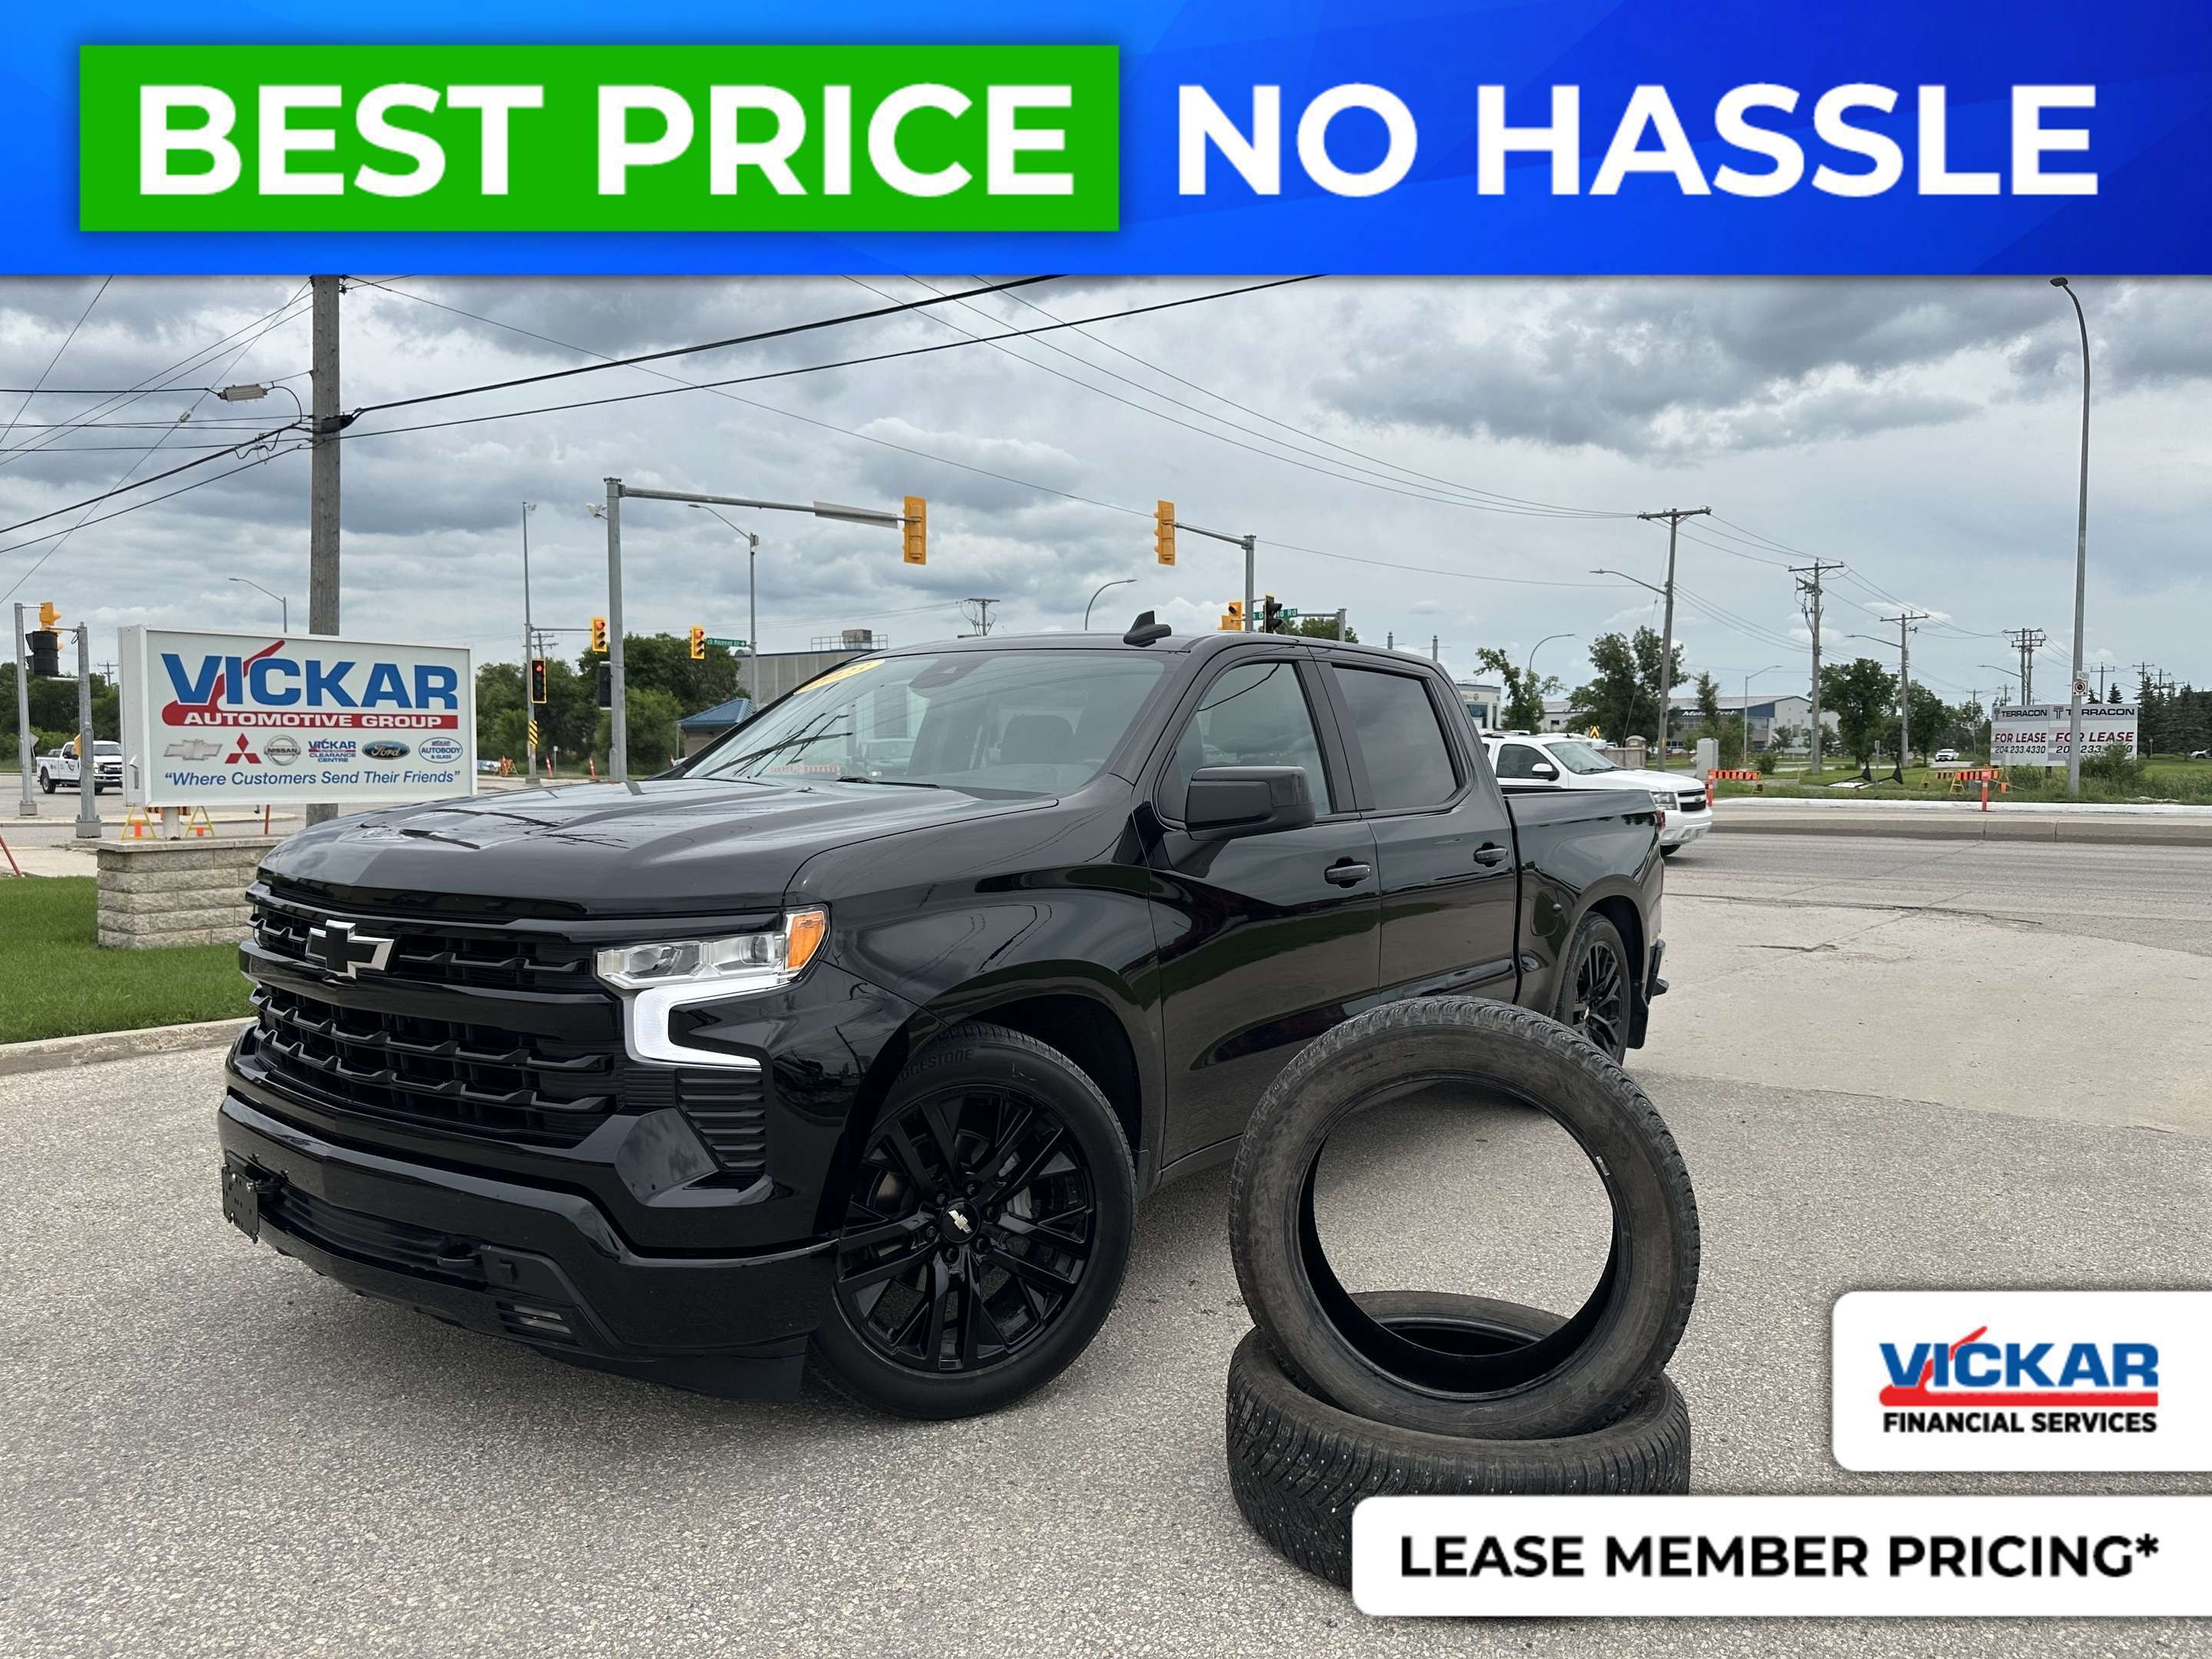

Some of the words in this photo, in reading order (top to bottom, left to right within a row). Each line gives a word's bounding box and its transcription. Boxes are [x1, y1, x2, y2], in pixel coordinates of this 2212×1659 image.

[161, 653, 458, 710] VICKAR
[2001, 709, 2047, 718] TERRACON
[184, 712, 353, 727] AUTOMOTIVE
[361, 715, 442, 728] GROUP
[1995, 733, 2013, 743] FOR
[2015, 732, 2046, 743] LEASE
[2088, 731, 2134, 743] LEASE
[308, 740, 356, 750] VICKAR
[372, 743, 401, 756] Ford
[1995, 745, 2046, 754] 204.233.4330
[232, 771, 316, 785] Customers
[321, 771, 359, 784] Send
[364, 770, 399, 783] Their
